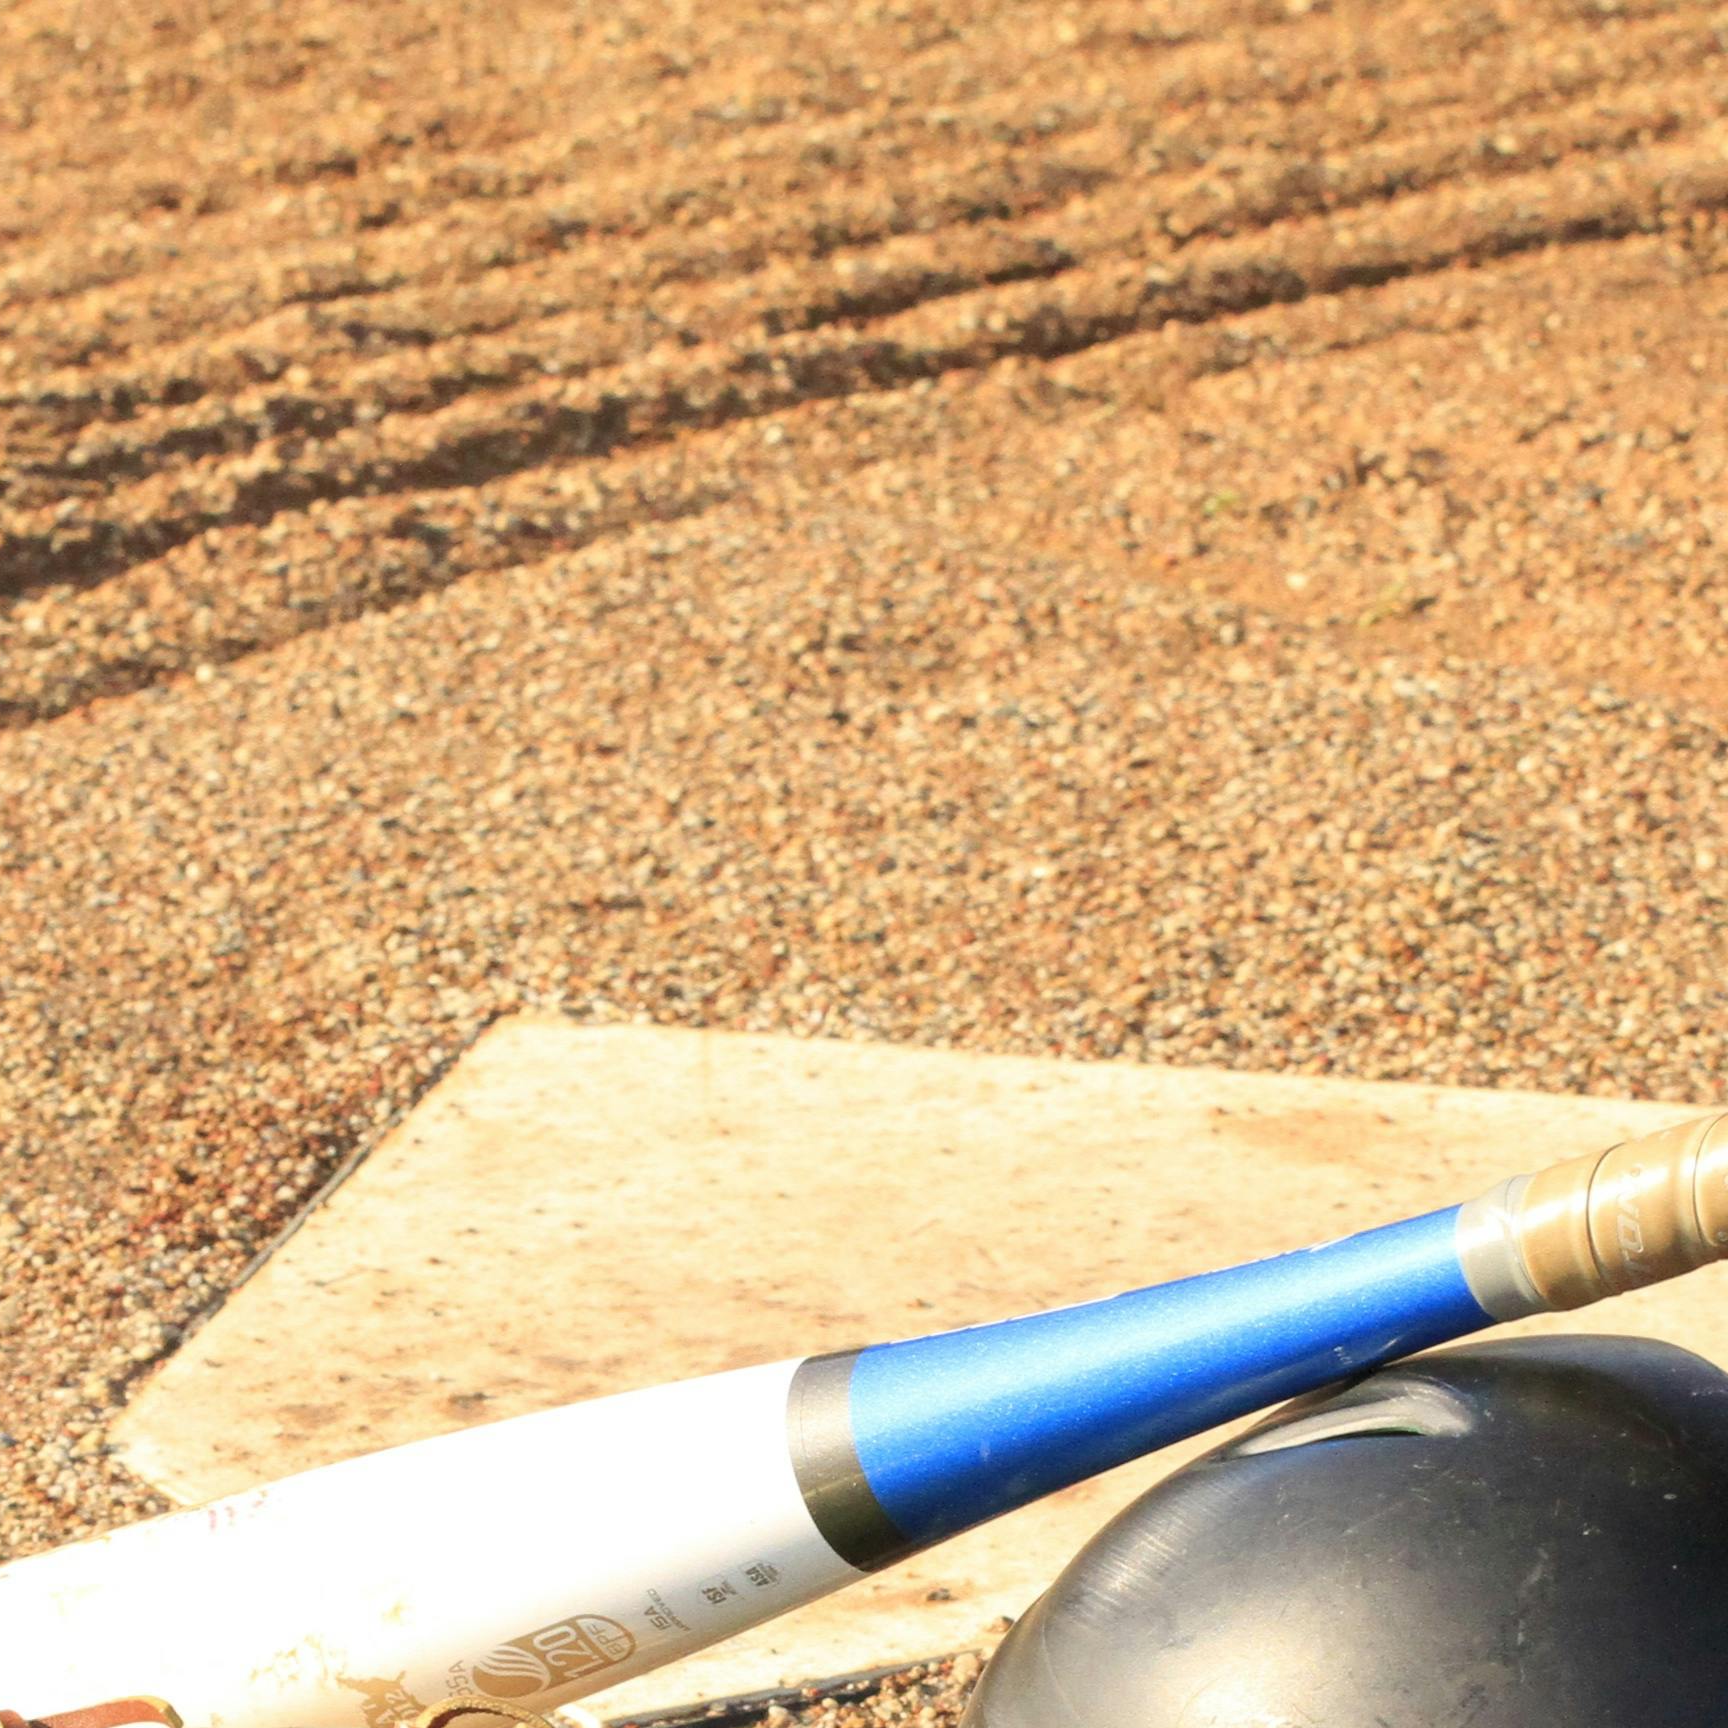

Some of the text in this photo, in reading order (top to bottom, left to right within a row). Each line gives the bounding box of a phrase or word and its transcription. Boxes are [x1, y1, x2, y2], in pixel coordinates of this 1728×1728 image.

[744, 1564, 770, 1587] ASA
[643, 1605, 672, 1632] ISA
[533, 1624, 601, 1682] 1.20
[587, 1623, 625, 1657] BPF
